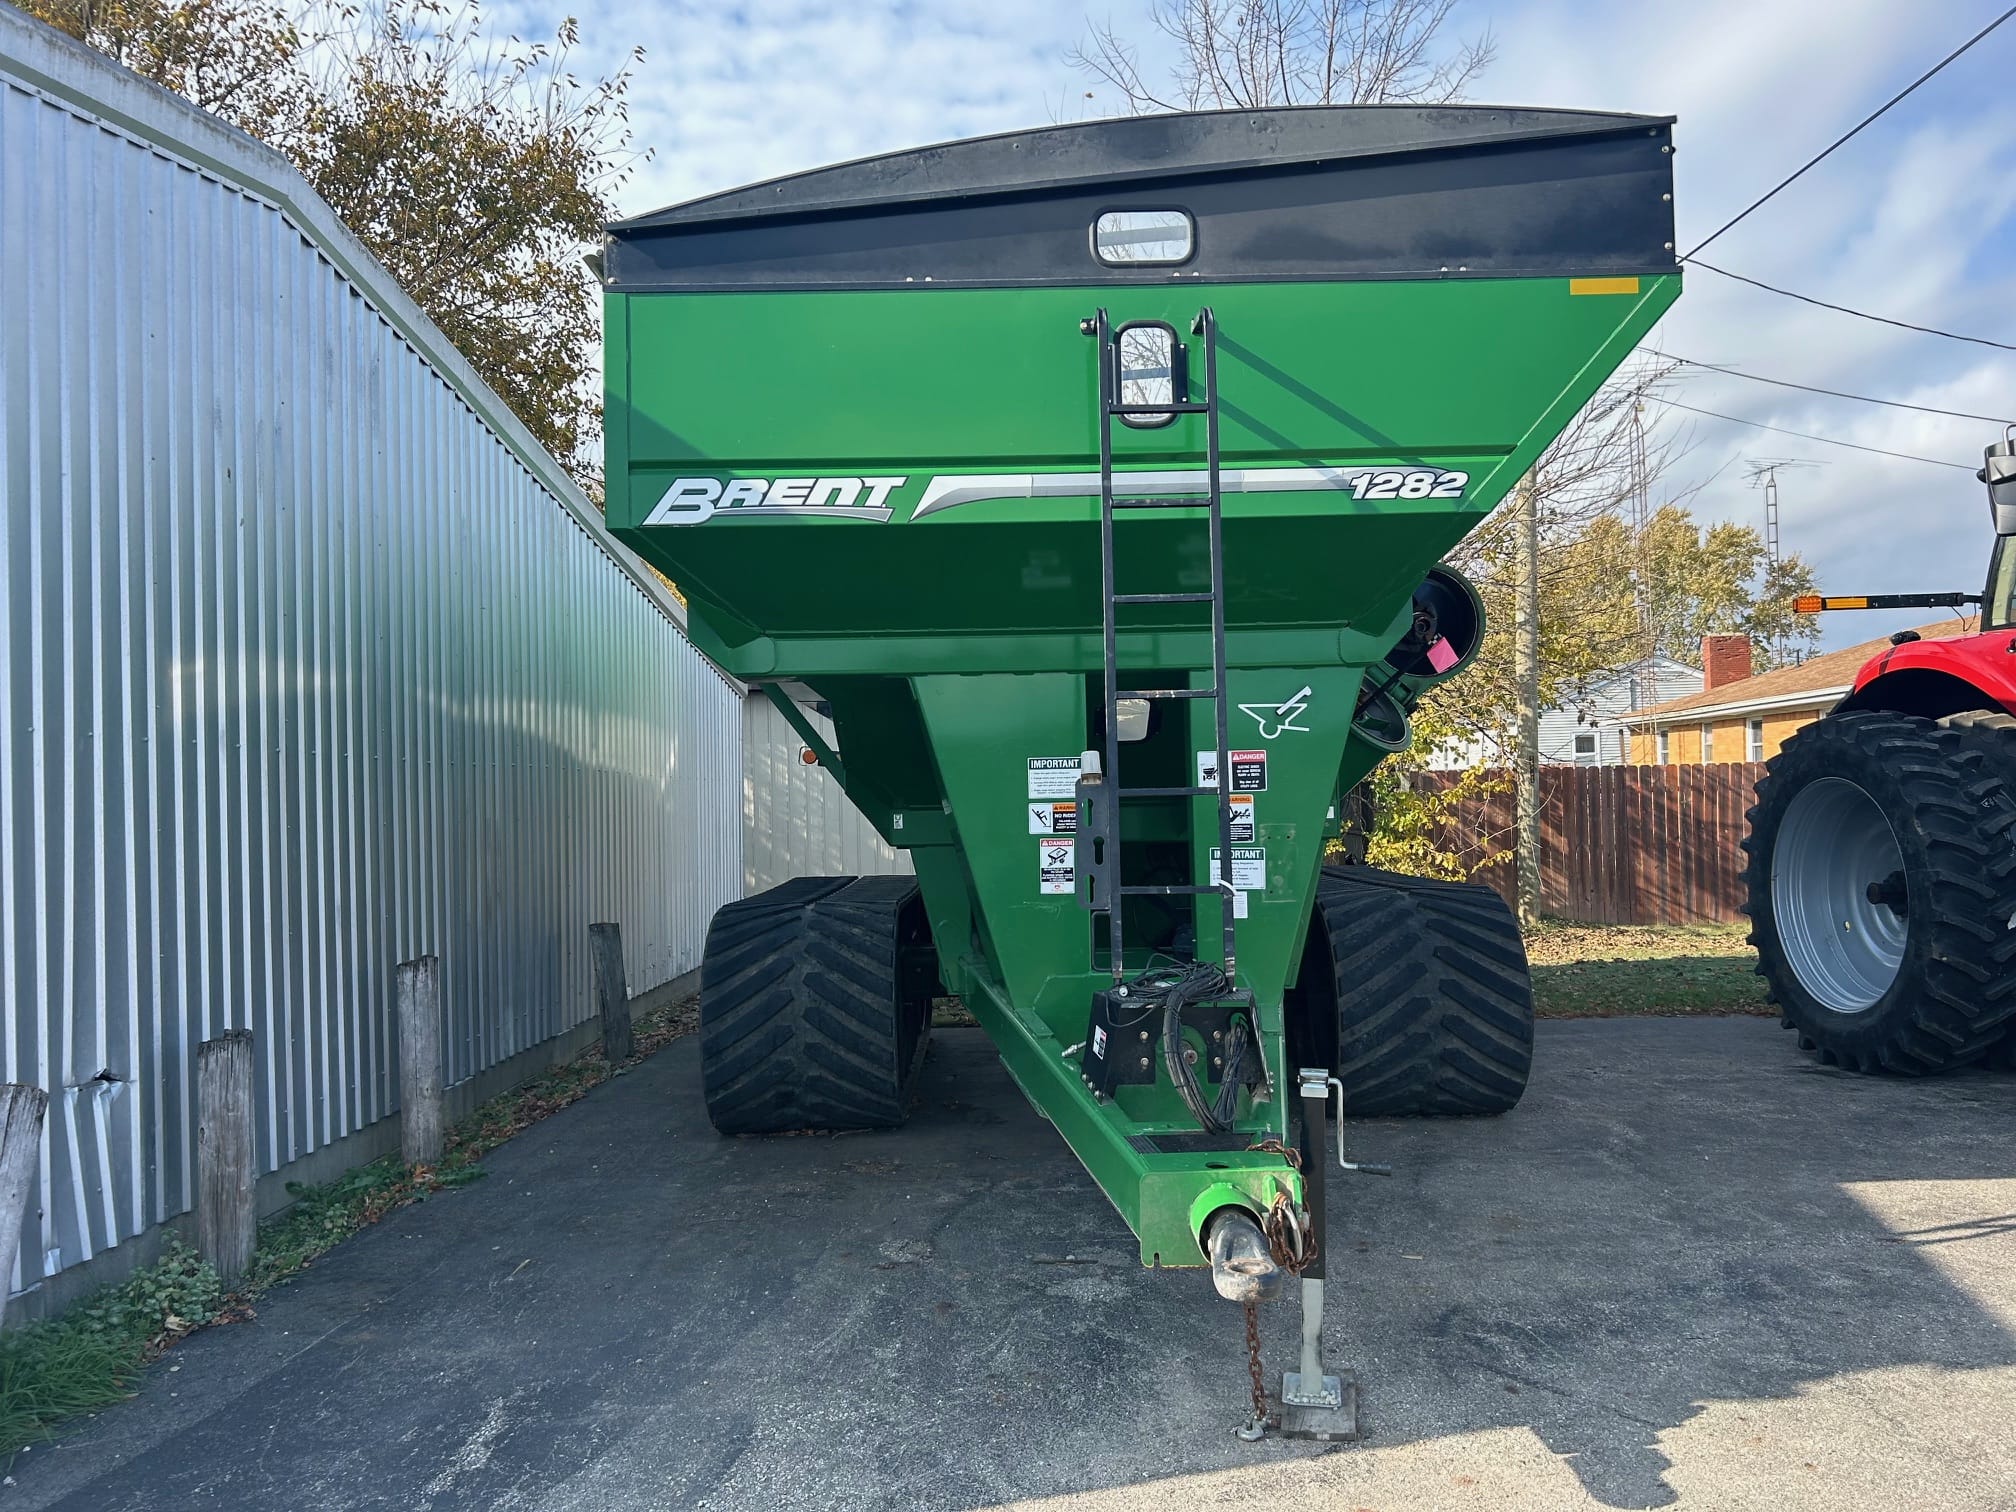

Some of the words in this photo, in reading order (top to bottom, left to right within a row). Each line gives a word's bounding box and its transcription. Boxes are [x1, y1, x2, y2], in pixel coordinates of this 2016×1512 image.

[1349, 471, 1469, 500] 1282
[640, 476, 908, 527] BRENT
[1031, 760, 1079, 769] IMPORTANT
